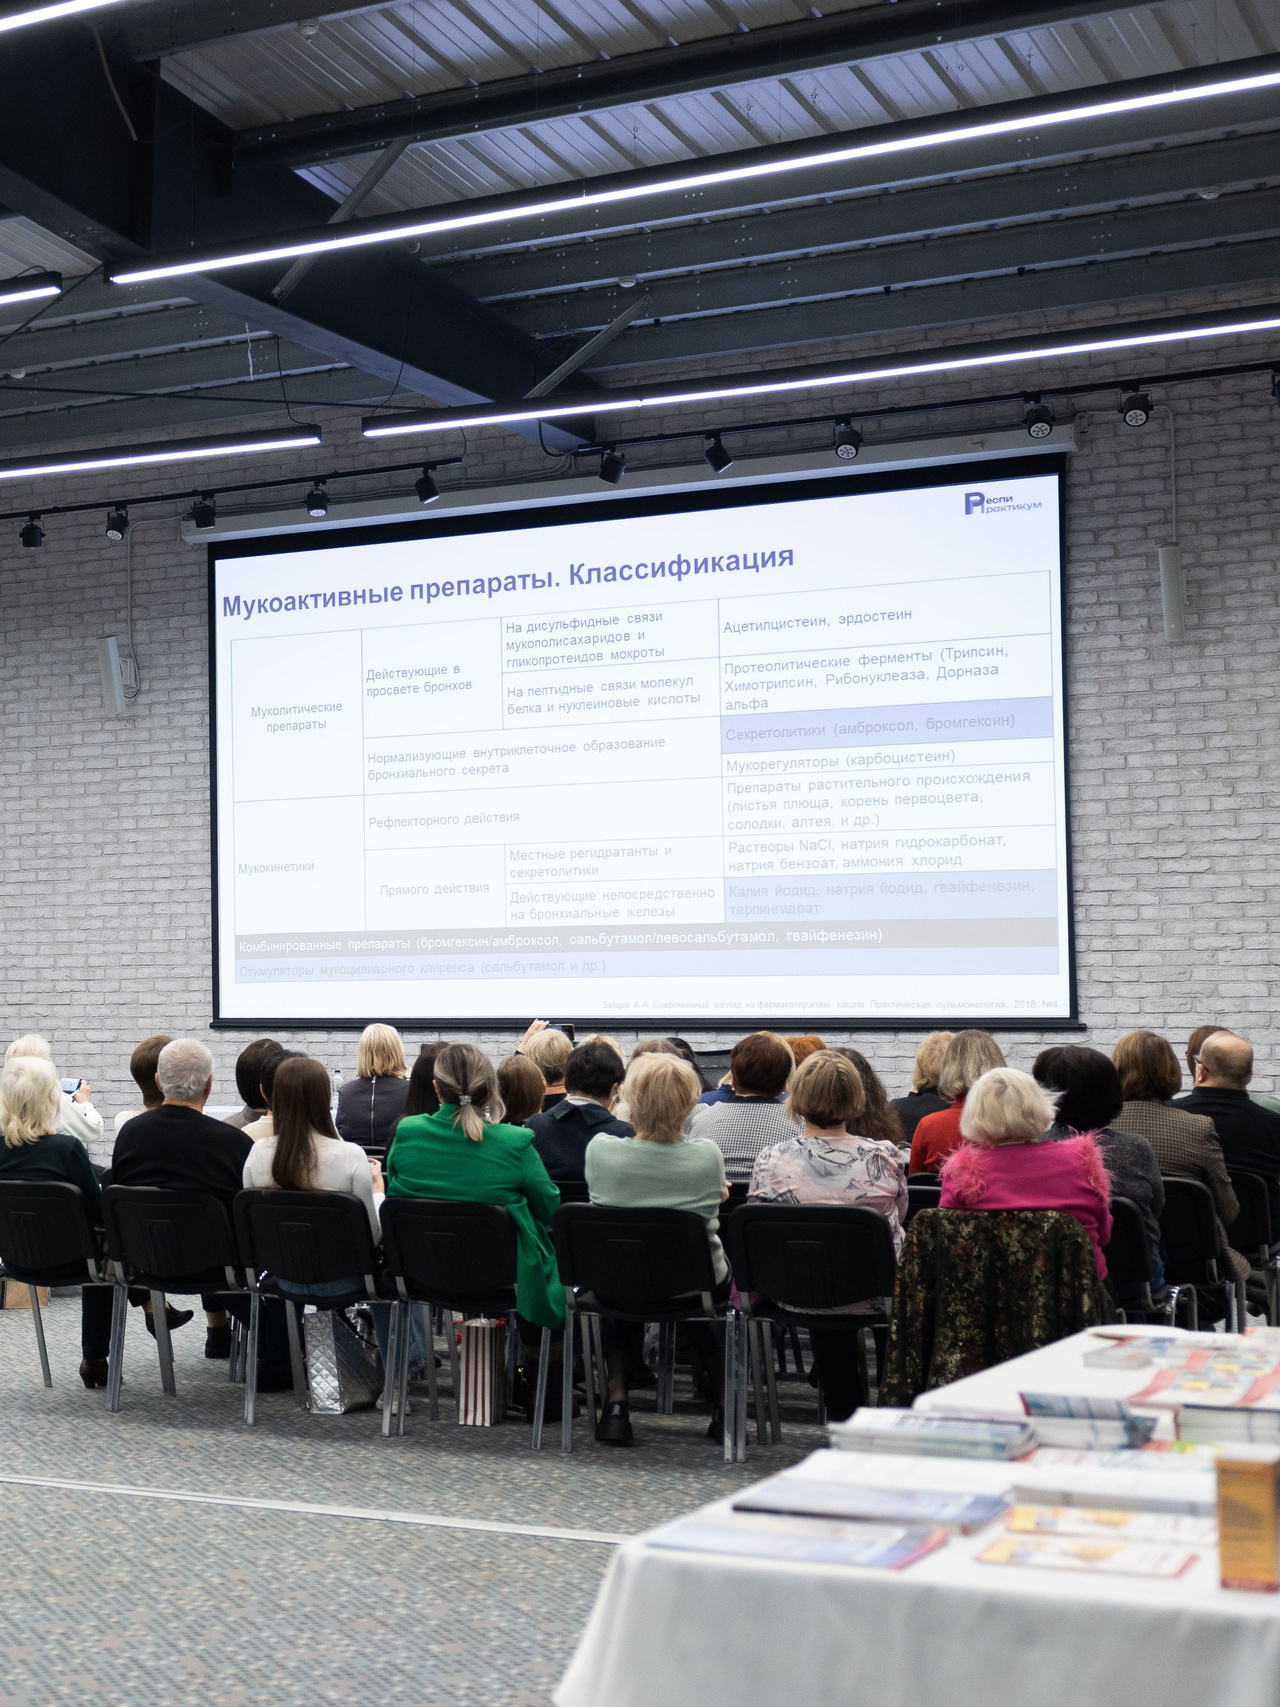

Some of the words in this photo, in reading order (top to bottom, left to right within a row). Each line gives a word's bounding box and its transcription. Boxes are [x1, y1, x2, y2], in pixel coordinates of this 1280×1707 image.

[222, 585, 403, 621] Мукоактивные
[410, 571, 560, 604] препараты.
[569, 548, 794, 586] Классификация
[506, 622, 522, 634] На
[525, 615, 620, 634] дисульфидные
[626, 612, 663, 624] связи
[723, 616, 830, 635] Ацетилцистеин,
[838, 609, 912, 627] эрдостеин
[506, 632, 631, 653] мукополисахаридов
[637, 631, 645, 640] и
[506, 652, 604, 668] гликопротеидов
[610, 647, 665, 661] мокроты
[724, 657, 851, 677] Протеолитические
[857, 651, 932, 668] ферменты
[939, 646, 1008, 663] (Трипсин,
[365, 666, 448, 683] Действующие
[453, 665, 460, 674] в
[724, 677, 817, 692] Химотрипсин,
[825, 670, 929, 686] Рибонуклеаза,
[935, 665, 999, 682] Дорназа
[366, 684, 420, 699] просвете
[423, 680, 472, 695] бронхов
[506, 686, 523, 698] На
[527, 683, 594, 697] пептидные
[600, 680, 636, 692] связи
[640, 676, 694, 689] молекул
[251, 702, 343, 719] Муколитические
[507, 703, 542, 715] белка
[547, 703, 554, 712] и
[558, 697, 640, 714] нуклеиновые
[647, 693, 700, 706] кислоты
[724, 697, 769, 712] альфа
[266, 720, 327, 734] препараты
[725, 726, 825, 742] Секретолитики
[833, 720, 918, 737] (амброксол,
[925, 712, 1016, 732] бромгексин)
[367, 749, 467, 766] Нормализующие
[473, 743, 577, 760] внутриклеточное
[582, 738, 666, 753] образование
[726, 757, 839, 774] Мукорегуляторы
[845, 748, 955, 769] (карбоцистеин)
[367, 767, 456, 782] бронхиального
[461, 764, 509, 777] секрета
[727, 782, 801, 796] Препараты
[808, 777, 911, 793] растительного
[916, 771, 1031, 789] происхождения
[727, 800, 777, 814] (листья
[783, 798, 833, 811] плюща,
[840, 796, 889, 810] корень
[894, 792, 983, 808] первоцвета,
[368, 815, 460, 830] Рефлекторного
[463, 812, 520, 826] действия
[727, 819, 785, 831] солодки,
[791, 817, 835, 828] алтея,
[840, 816, 849, 826] и
[852, 812, 880, 829] др.)
[728, 841, 794, 855] Растворы
[799, 838, 835, 852] NaCl,
[841, 839, 889, 852] натрия
[895, 833, 1006, 851] гидрокарбонат,
[509, 849, 566, 861] Местные
[569, 847, 658, 862] регидратанты
[664, 846, 672, 856] и
[238, 862, 315, 876] Мукокинетики
[509, 866, 599, 880] секретолитики
[728, 860, 774, 873] натрия
[779, 857, 838, 870] бензоат,
[842, 857, 904, 868] аммония
[911, 855, 963, 869] хлорид
[379, 884, 429, 898] Прямого
[433, 882, 490, 896] действия
[509, 891, 597, 906] Действующие
[602, 888, 715, 902] непосредственно
[729, 885, 768, 898] Калия
[774, 884, 819, 898] йодид,
[826, 884, 874, 897] натрия
[879, 881, 927, 896] йодид,
[933, 879, 1035, 896] гвайфенезин,
[510, 911, 525, 920] на
[529, 907, 620, 922] бронхиальные
[625, 907, 675, 917] железы
[728, 903, 821, 918] терпингидрат
[239, 940, 342, 953] Комбинированные
[348, 939, 410, 952] препараты
[416, 934, 562, 951] (бромгексин/амброксол,
[569, 930, 779, 947] сальбутамол/левосальбутамол,
[786, 927, 883, 944] гвайфенезин)
[238, 965, 314, 978] Стимуляторы
[319, 964, 415, 978] мукоцилиарного
[420, 963, 475, 976] клиренса
[480, 960, 565, 975] (сальбутамол
[570, 961, 578, 971] и
[581, 959, 606, 974] др.)
